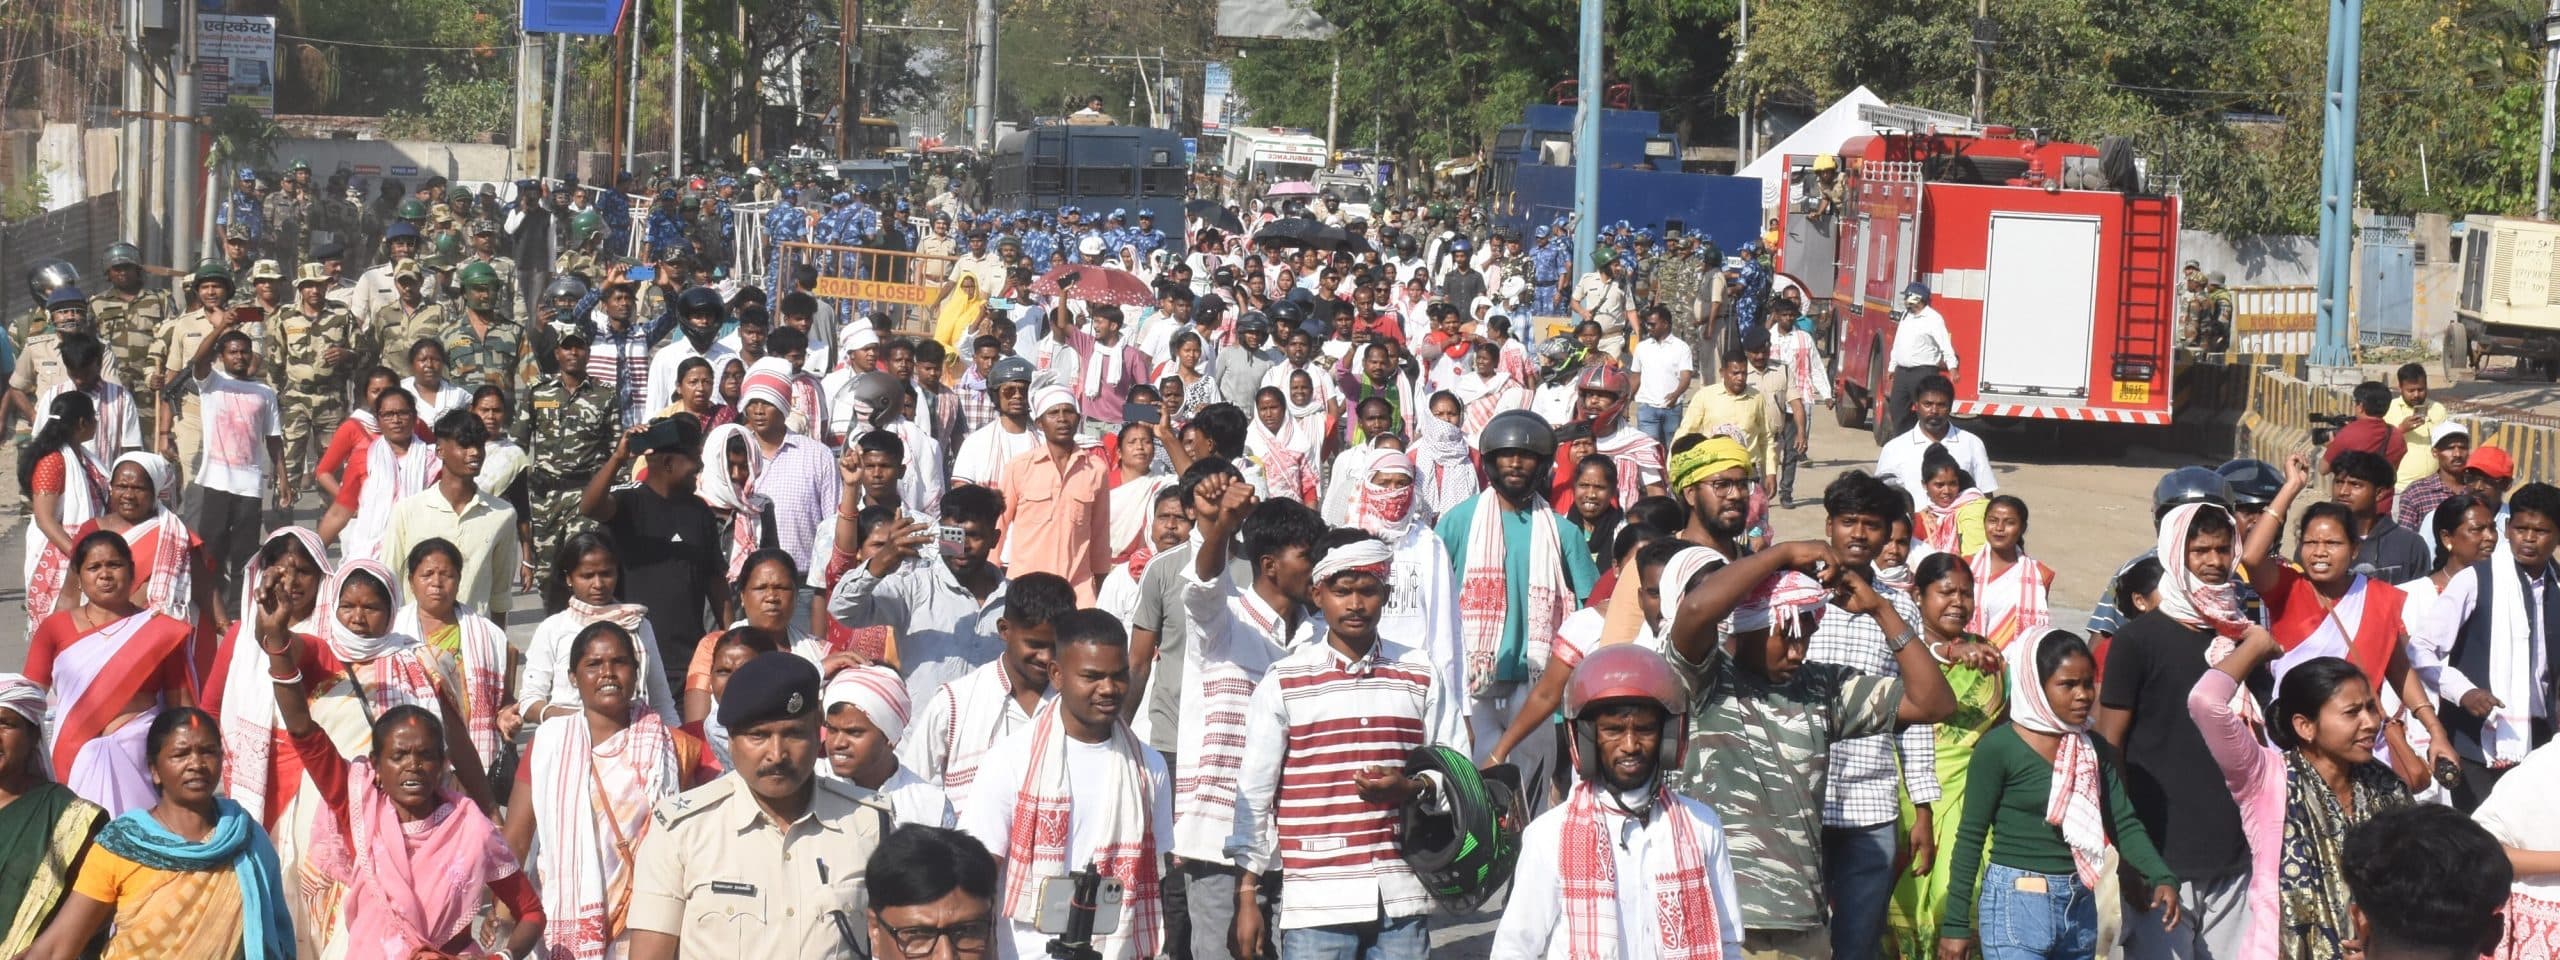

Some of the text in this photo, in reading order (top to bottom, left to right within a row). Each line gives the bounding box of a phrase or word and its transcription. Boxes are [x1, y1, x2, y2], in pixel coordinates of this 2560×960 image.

[820, 279, 927, 302] ROAD CLOSED
[2250, 315, 2317, 331] ROAD CLOSE
